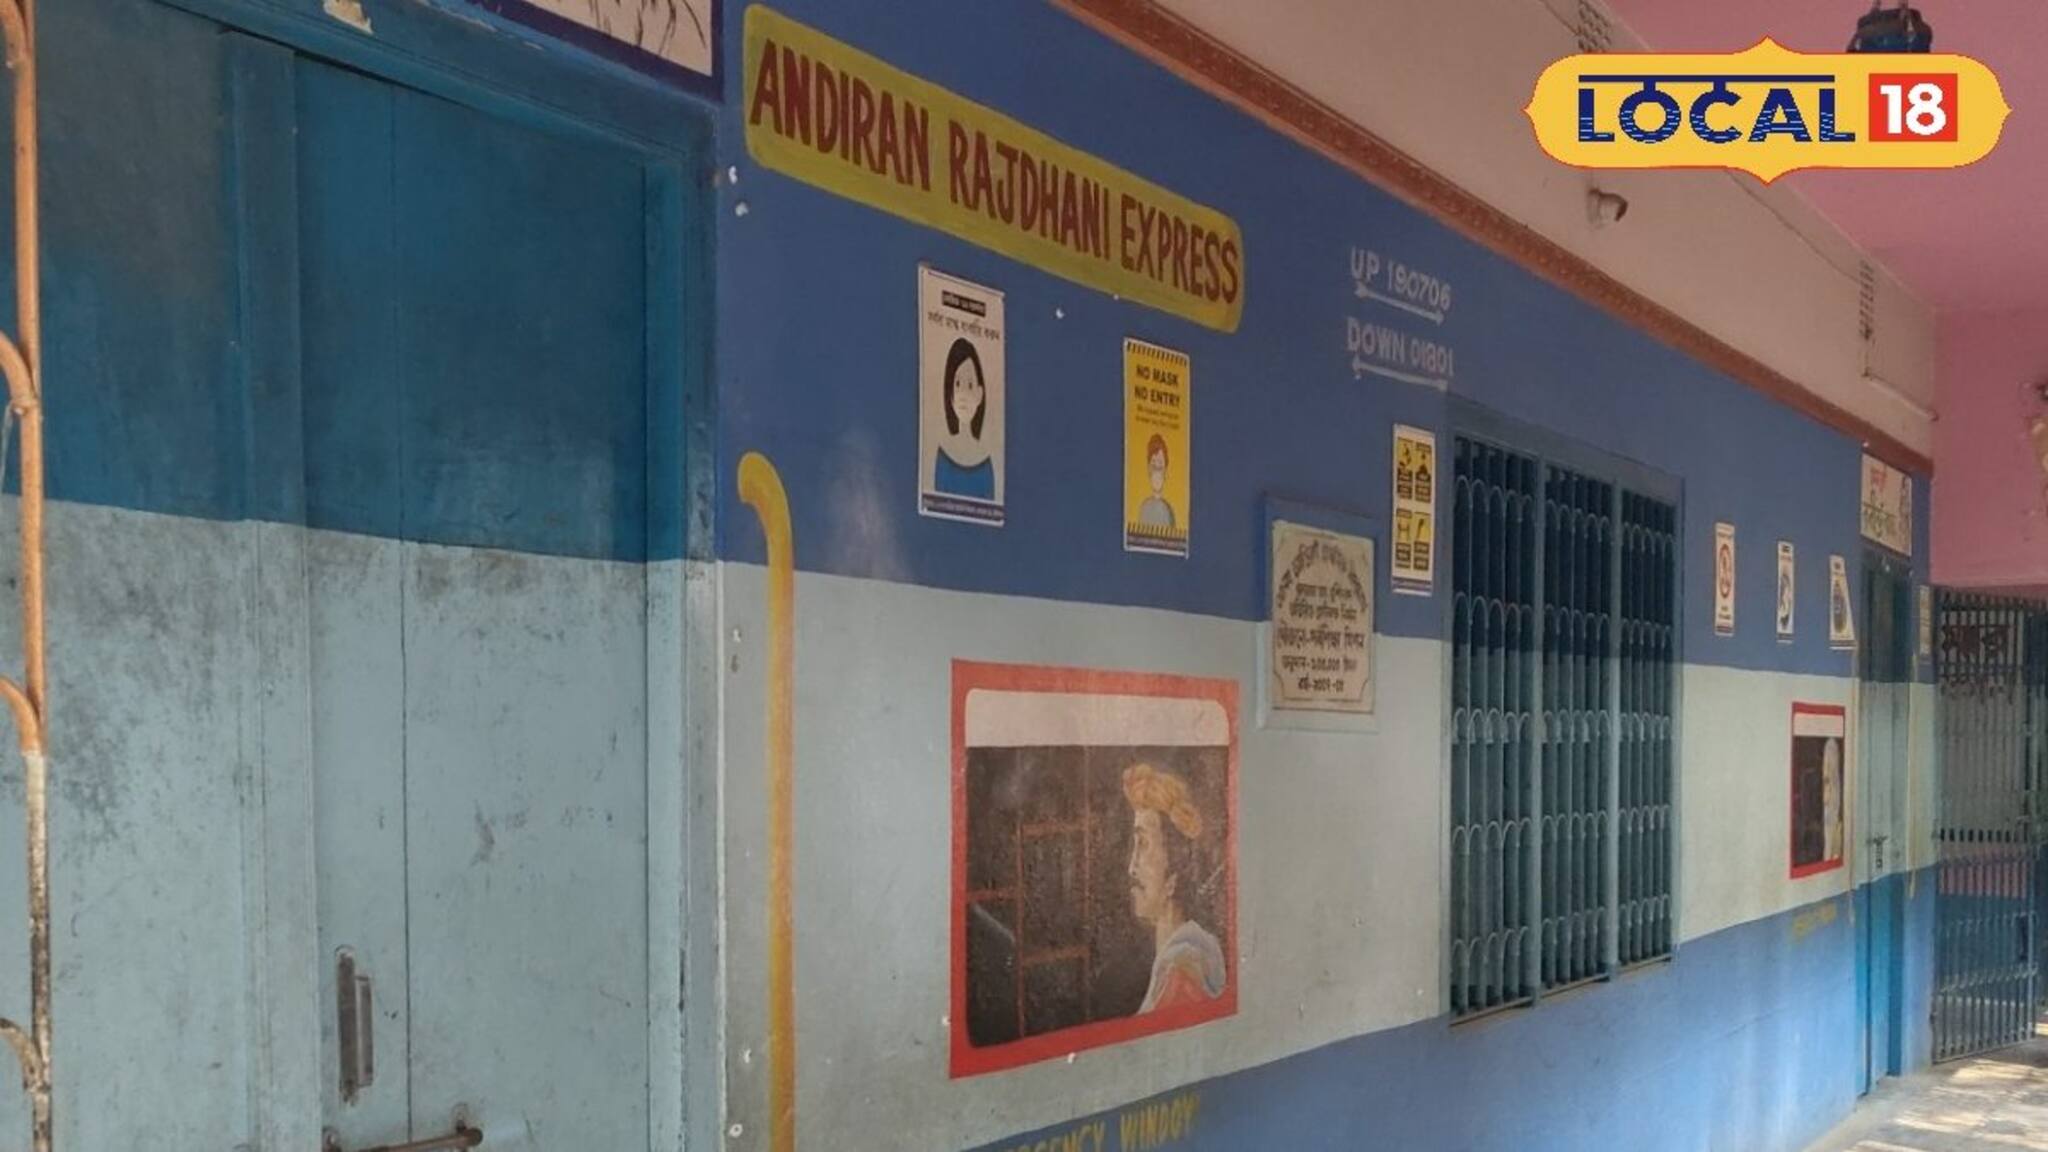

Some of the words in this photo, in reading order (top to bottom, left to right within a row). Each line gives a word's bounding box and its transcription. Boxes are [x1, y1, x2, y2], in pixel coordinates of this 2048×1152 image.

[749, 38, 931, 192] ANDIRAN
[948, 119, 1111, 261] RAJDHANI
[1120, 193, 1239, 305] EXPRESS
[1351, 246, 1380, 281] UP
[1347, 316, 1406, 365] DOWN
[1136, 364, 1150, 381] NO
[1152, 367, 1179, 388] MASK
[1134, 385, 1148, 401] NO
[1150, 388, 1180, 408] ENTRY
